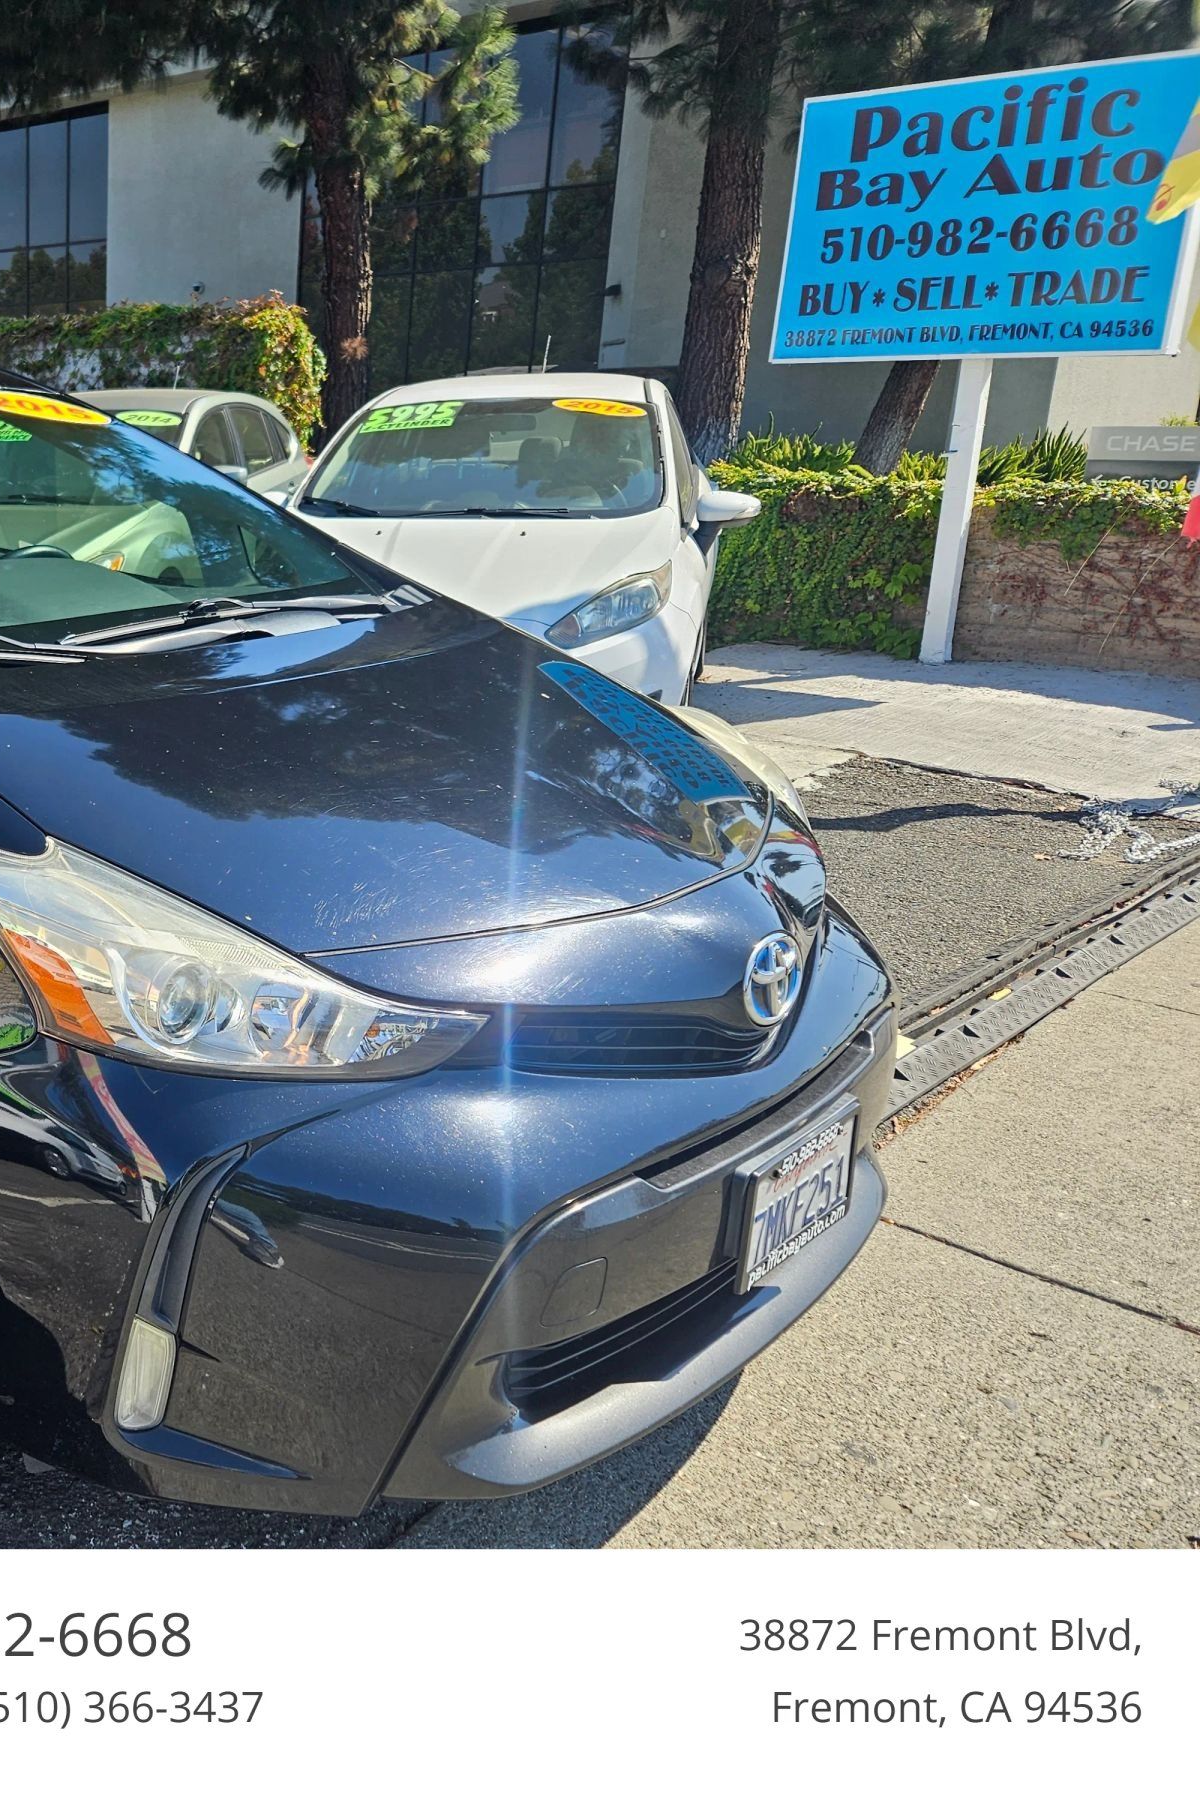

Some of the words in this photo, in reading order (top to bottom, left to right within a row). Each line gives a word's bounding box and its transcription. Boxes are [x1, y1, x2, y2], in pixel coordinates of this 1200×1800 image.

[849, 77, 1142, 163] Pacific
[816, 167, 948, 212] Bay
[963, 143, 1167, 199] Auto
[820, 206, 1139, 264] 510-982-6668
[785, 329, 836, 347] 38872
[841, 326, 917, 345] FREMONT
[919, 325, 963, 344] BLVD,
[968, 322, 1054, 342] FREMONT,
[1060, 320, 1084, 338] CA
[1089, 319, 1154, 337] 94536
[126, 414, 173, 425] 2014
[365, 401, 464, 426] 5995
[565, 400, 634, 415] 2015
[1106, 435, 1198, 452] CHASE
[755, 1155, 845, 1264] 7MKF251
